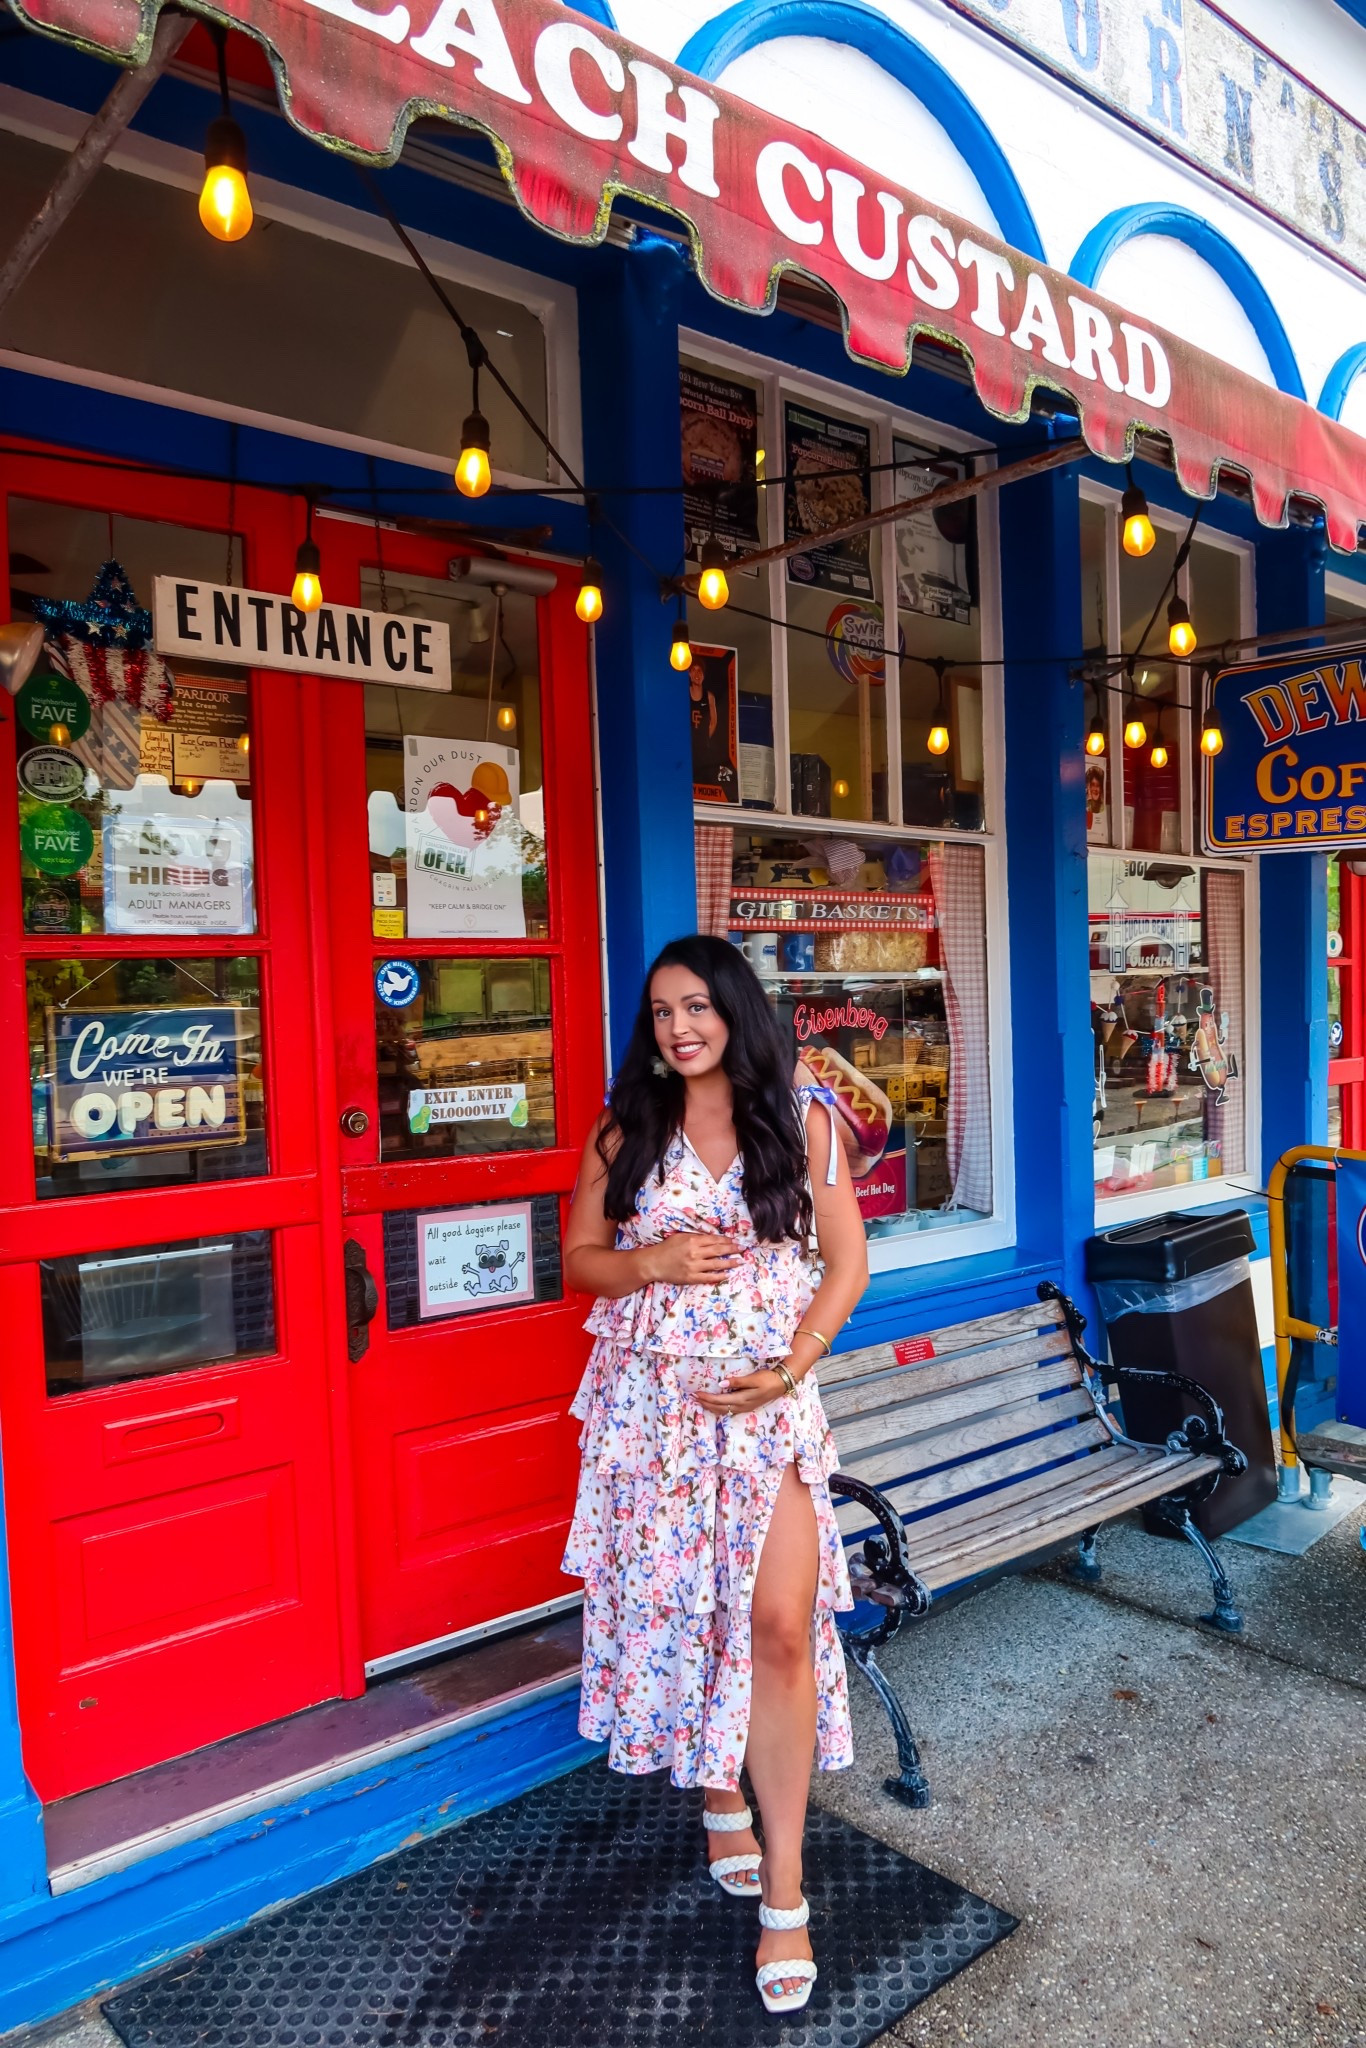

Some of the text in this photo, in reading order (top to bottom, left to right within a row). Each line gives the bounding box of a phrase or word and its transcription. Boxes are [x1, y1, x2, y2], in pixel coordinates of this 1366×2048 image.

[755, 141, 1171, 409] CUSTARD
[682, 387, 731, 409] World Famous
[693, 377, 708, 389] New
[709, 382, 729, 395] Years
[730, 388, 743, 400] Eve
[706, 403, 727, 420] Ball
[728, 410, 754, 430] Drop
[791, 443, 825, 462] Popcorn
[827, 455, 843, 469] Ball
[175, 583, 433, 674] ENTRANCE
[844, 616, 883, 636] Swir
[31, 697, 77, 708] Neighborhood
[176, 688, 230, 703] PARLOUR
[31, 704, 77, 723] FAVE
[195, 702, 217, 710] Cream
[145, 731, 169, 743] Vanilla
[180, 734, 196, 745] Ice
[197, 736, 218, 747] Cream
[139, 749, 157, 762] Dairy
[144, 741, 173, 753] Custard
[423, 754, 446, 773] OUR
[451, 750, 483, 763] DUST
[698, 786, 723, 799] MOONEY
[1225, 805, 1366, 839] ESPRES
[34, 828, 80, 837] Neighborhood
[34, 835, 81, 852] FAVE
[423, 847, 467, 875] OPEN
[129, 866, 229, 887] HIRING
[429, 874, 460, 891] CHAGRIN
[463, 884, 482, 892] FALLS
[128, 900, 231, 910] ADULT MANAGERS
[736, 901, 919, 920] GIFT BASKETS
[1124, 919, 1175, 942] EUCLID BEACH
[380, 961, 416, 976] ONE MILLION
[1129, 950, 1173, 968] Custard
[377, 979, 385, 997] ACTS
[394, 987, 417, 1006] KINDNESS
[794, 998, 888, 1041] Eisenberg
[69, 1020, 225, 1080] Come In
[102, 1066, 168, 1087] WE'RE
[424, 1087, 513, 1105] EXIT ENTER
[69, 1084, 227, 1139] OPEN
[431, 1103, 506, 1120] SLOOOOWLY
[855, 1182, 895, 1198] Beef Hot Dog
[427, 1220, 521, 1242] All good doggies please
[428, 1256, 447, 1266] wait
[429, 1278, 459, 1292] outside
